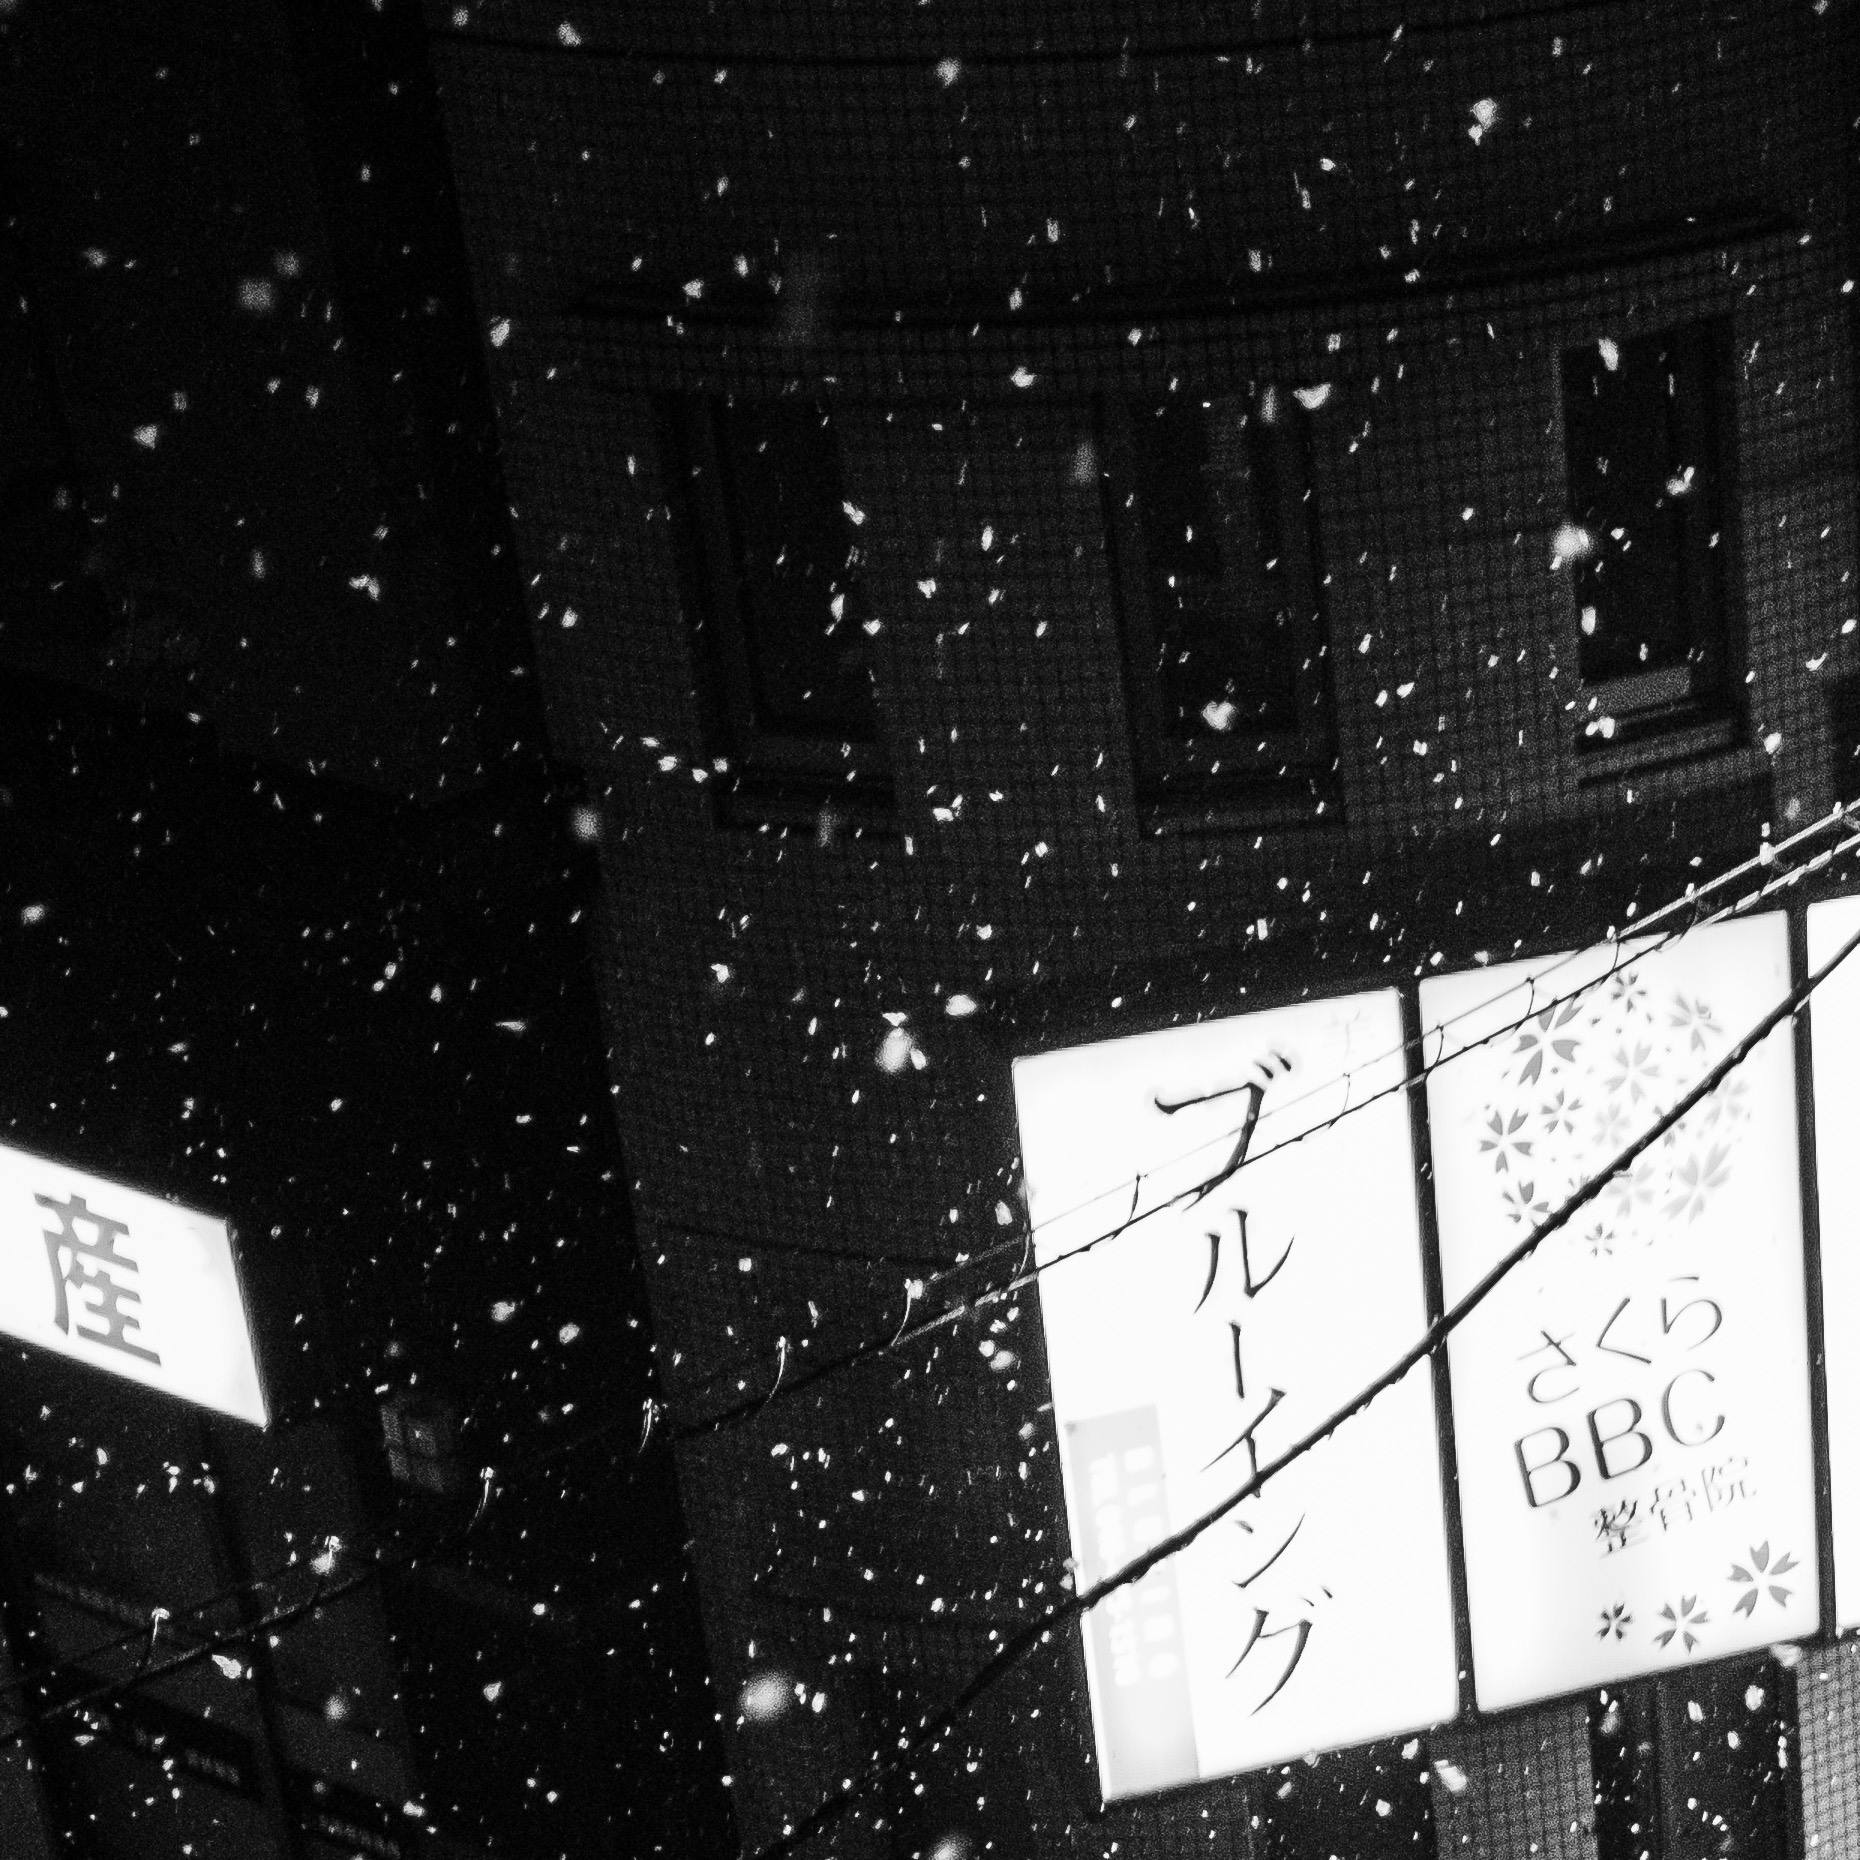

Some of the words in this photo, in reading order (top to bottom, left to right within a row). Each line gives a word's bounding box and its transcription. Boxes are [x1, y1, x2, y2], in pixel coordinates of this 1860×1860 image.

[34, 1193, 161, 1366] 産
[1516, 1276, 1722, 1404] さくら
[1155, 1051, 1332, 1715] ブルーイング
[1514, 1369, 1726, 1507] BBC
